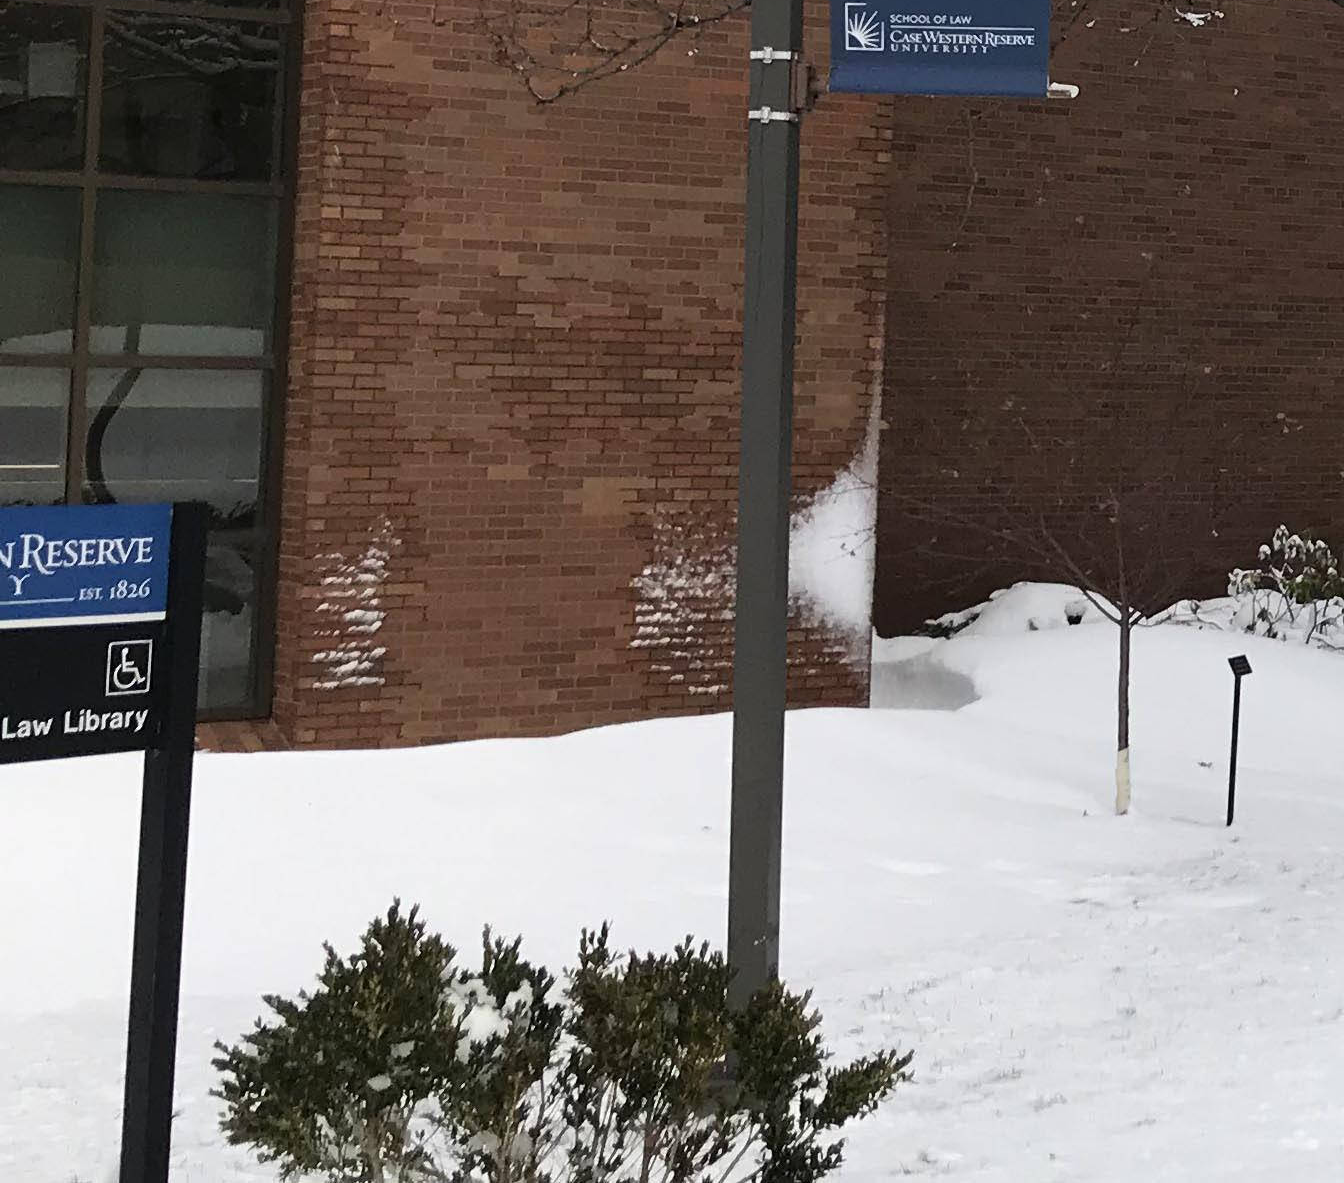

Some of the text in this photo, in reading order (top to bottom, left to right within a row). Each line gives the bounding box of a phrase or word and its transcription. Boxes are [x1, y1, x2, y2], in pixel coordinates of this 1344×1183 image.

[890, 14, 972, 25] SCHOOL OF LAW
[890, 43, 988, 54] UNIVERSITY
[19, 533, 154, 575] RESERVE
[109, 578, 152, 600] 1826
[1, 707, 149, 740] Law Library
